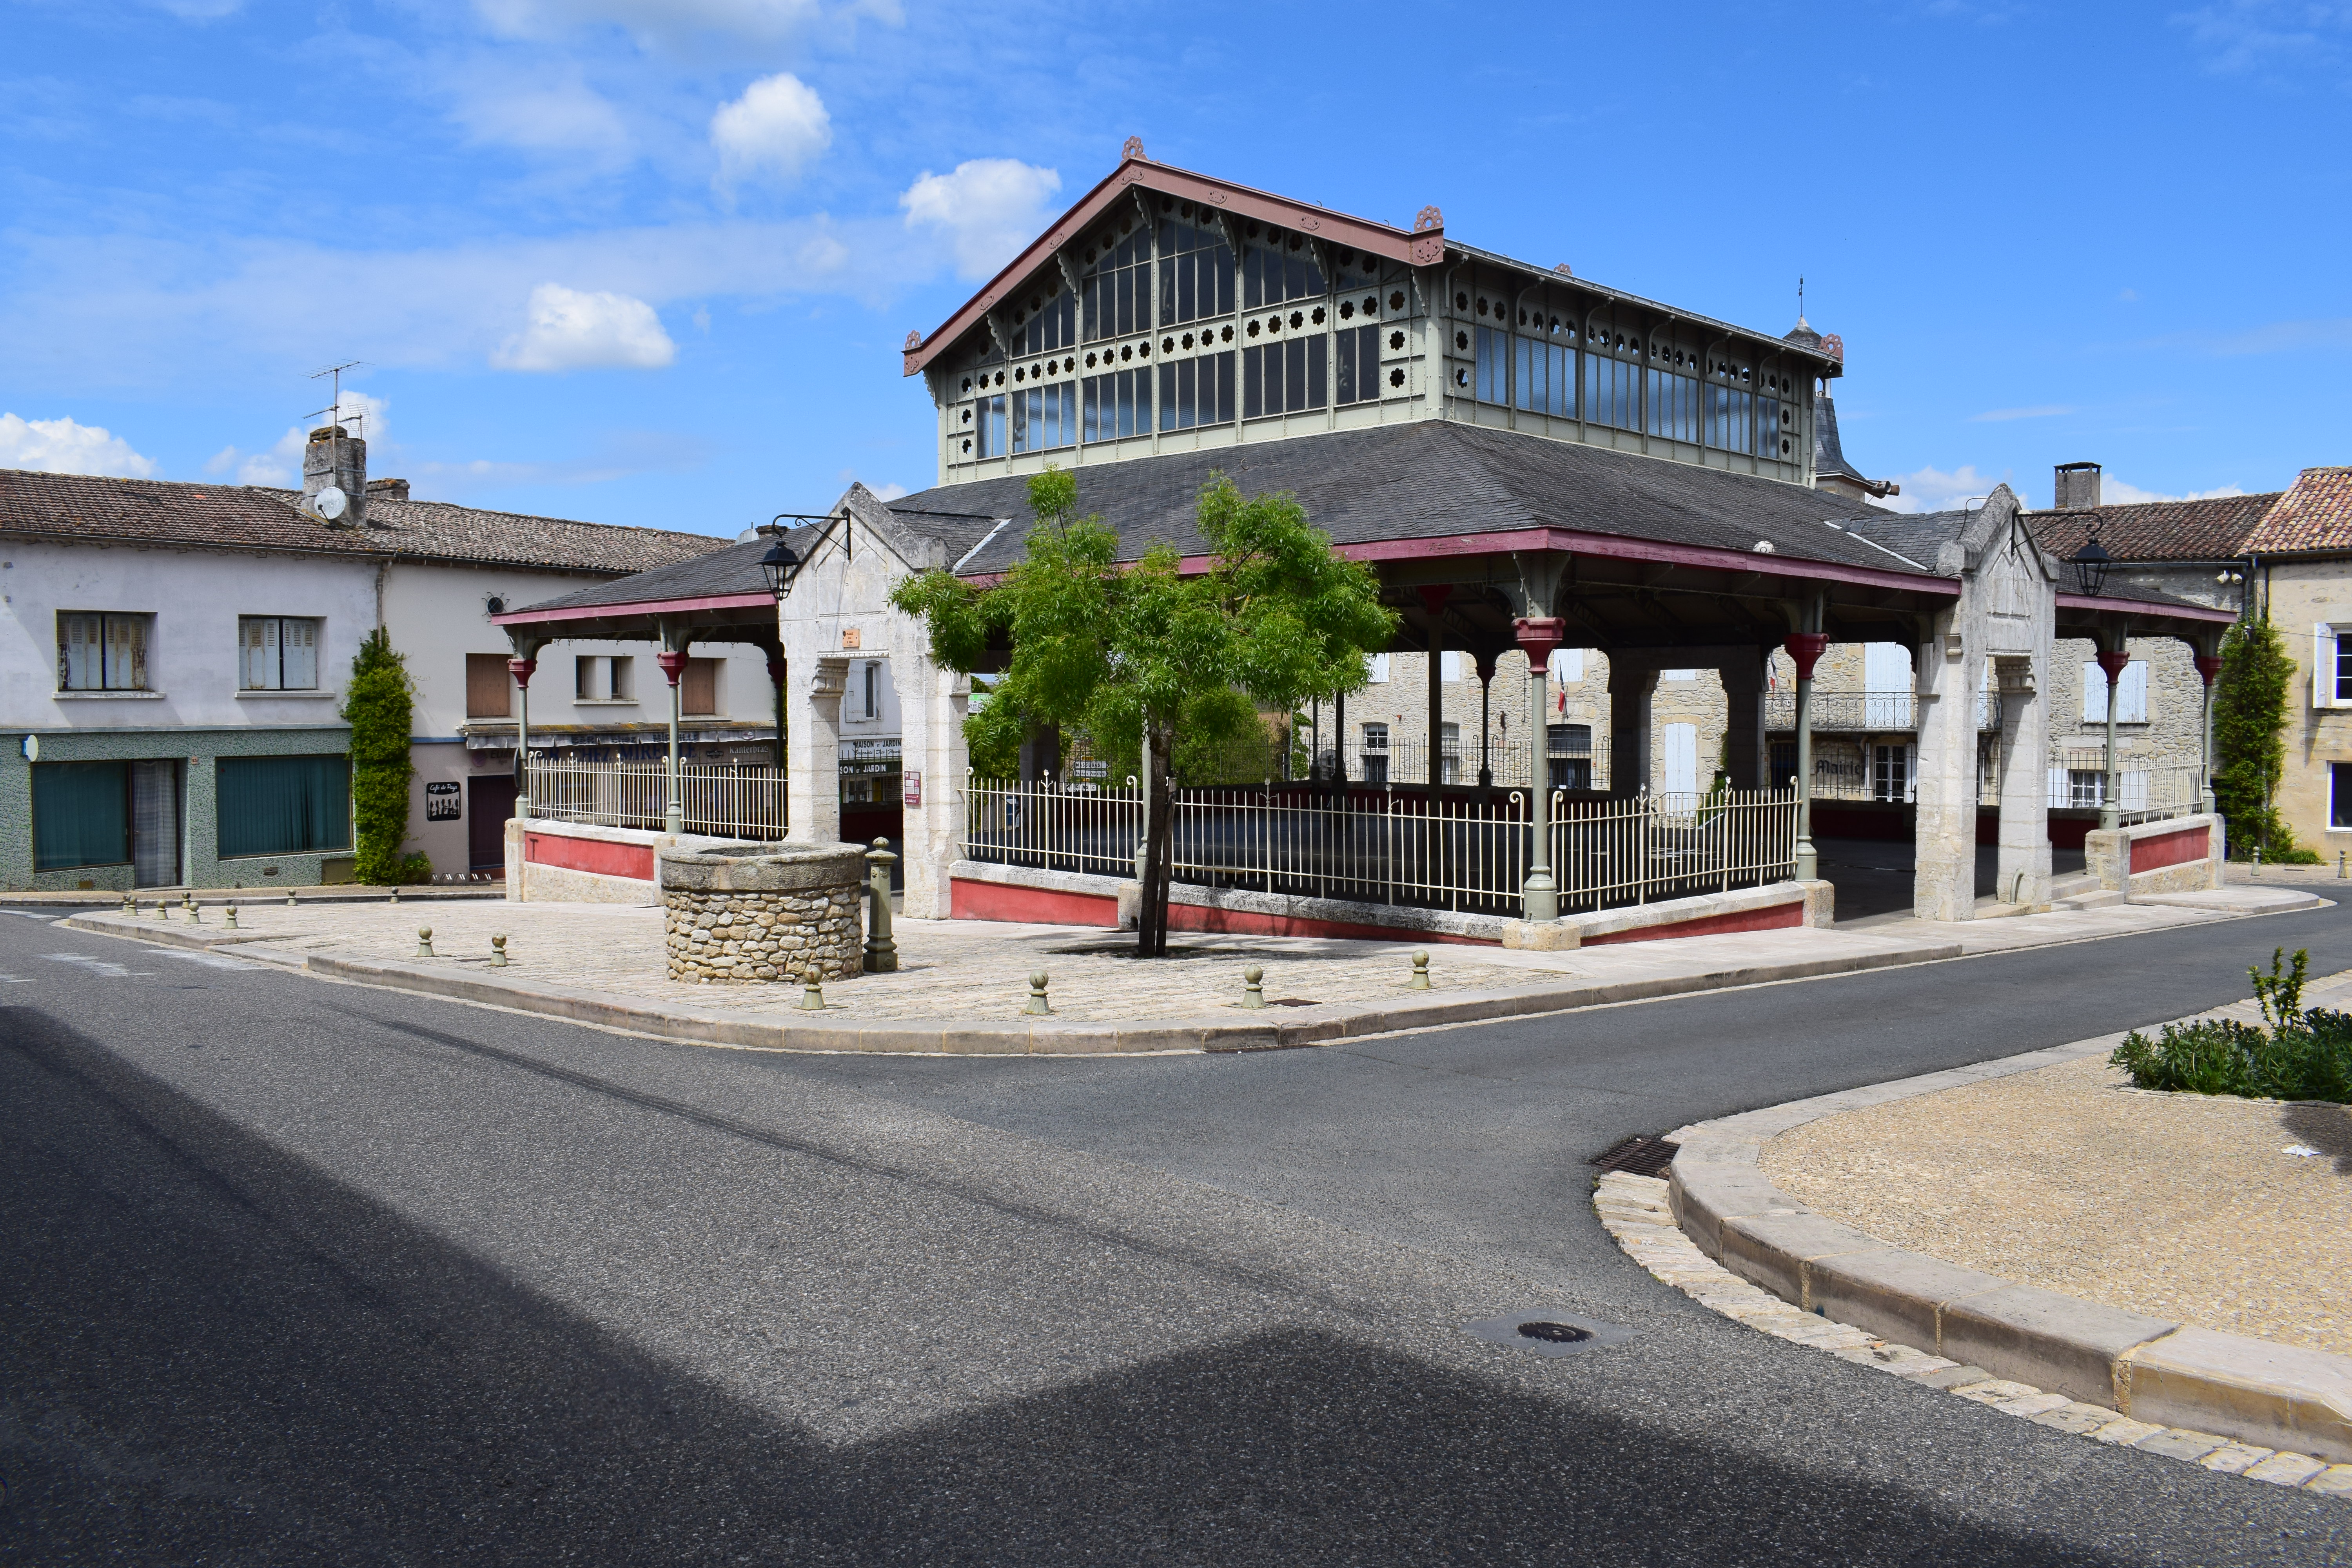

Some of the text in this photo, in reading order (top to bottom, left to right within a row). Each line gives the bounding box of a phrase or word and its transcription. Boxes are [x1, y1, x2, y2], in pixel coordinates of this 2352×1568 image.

[882, 739, 901, 748] JARDIN
[863, 764, 886, 773] JARDIN
[1817, 760, 1860, 775] Mairie
[430, 784, 440, 793] Café
